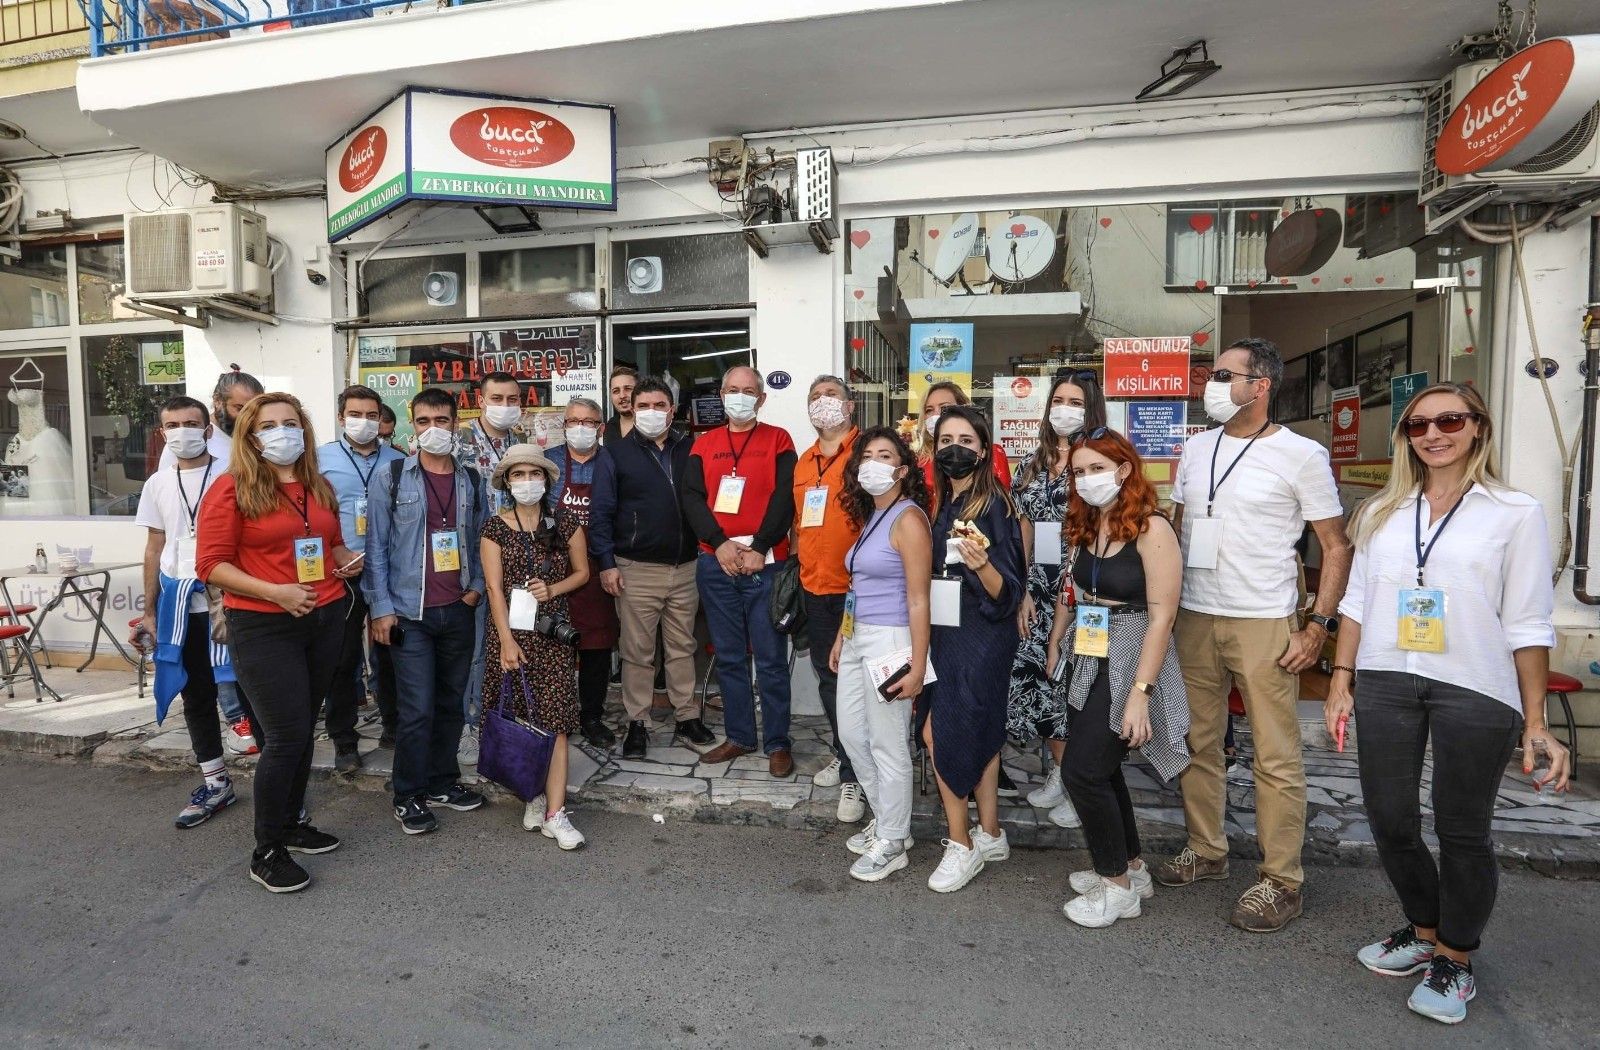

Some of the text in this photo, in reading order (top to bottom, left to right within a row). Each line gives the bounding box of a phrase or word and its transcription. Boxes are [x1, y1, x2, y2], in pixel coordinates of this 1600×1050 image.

[370, 181, 403, 210] MANDIRA
[422, 177, 607, 201] ZEYBEKOĞLU MANDIRA
[1107, 340, 1189, 353] SALONUMUZ
[1141, 359, 1149, 372] 6
[1117, 374, 1183, 394] KİŞİLİKTİR
[1403, 377, 1414, 394] 14
[1003, 420, 1040, 430] SAĞLIK
